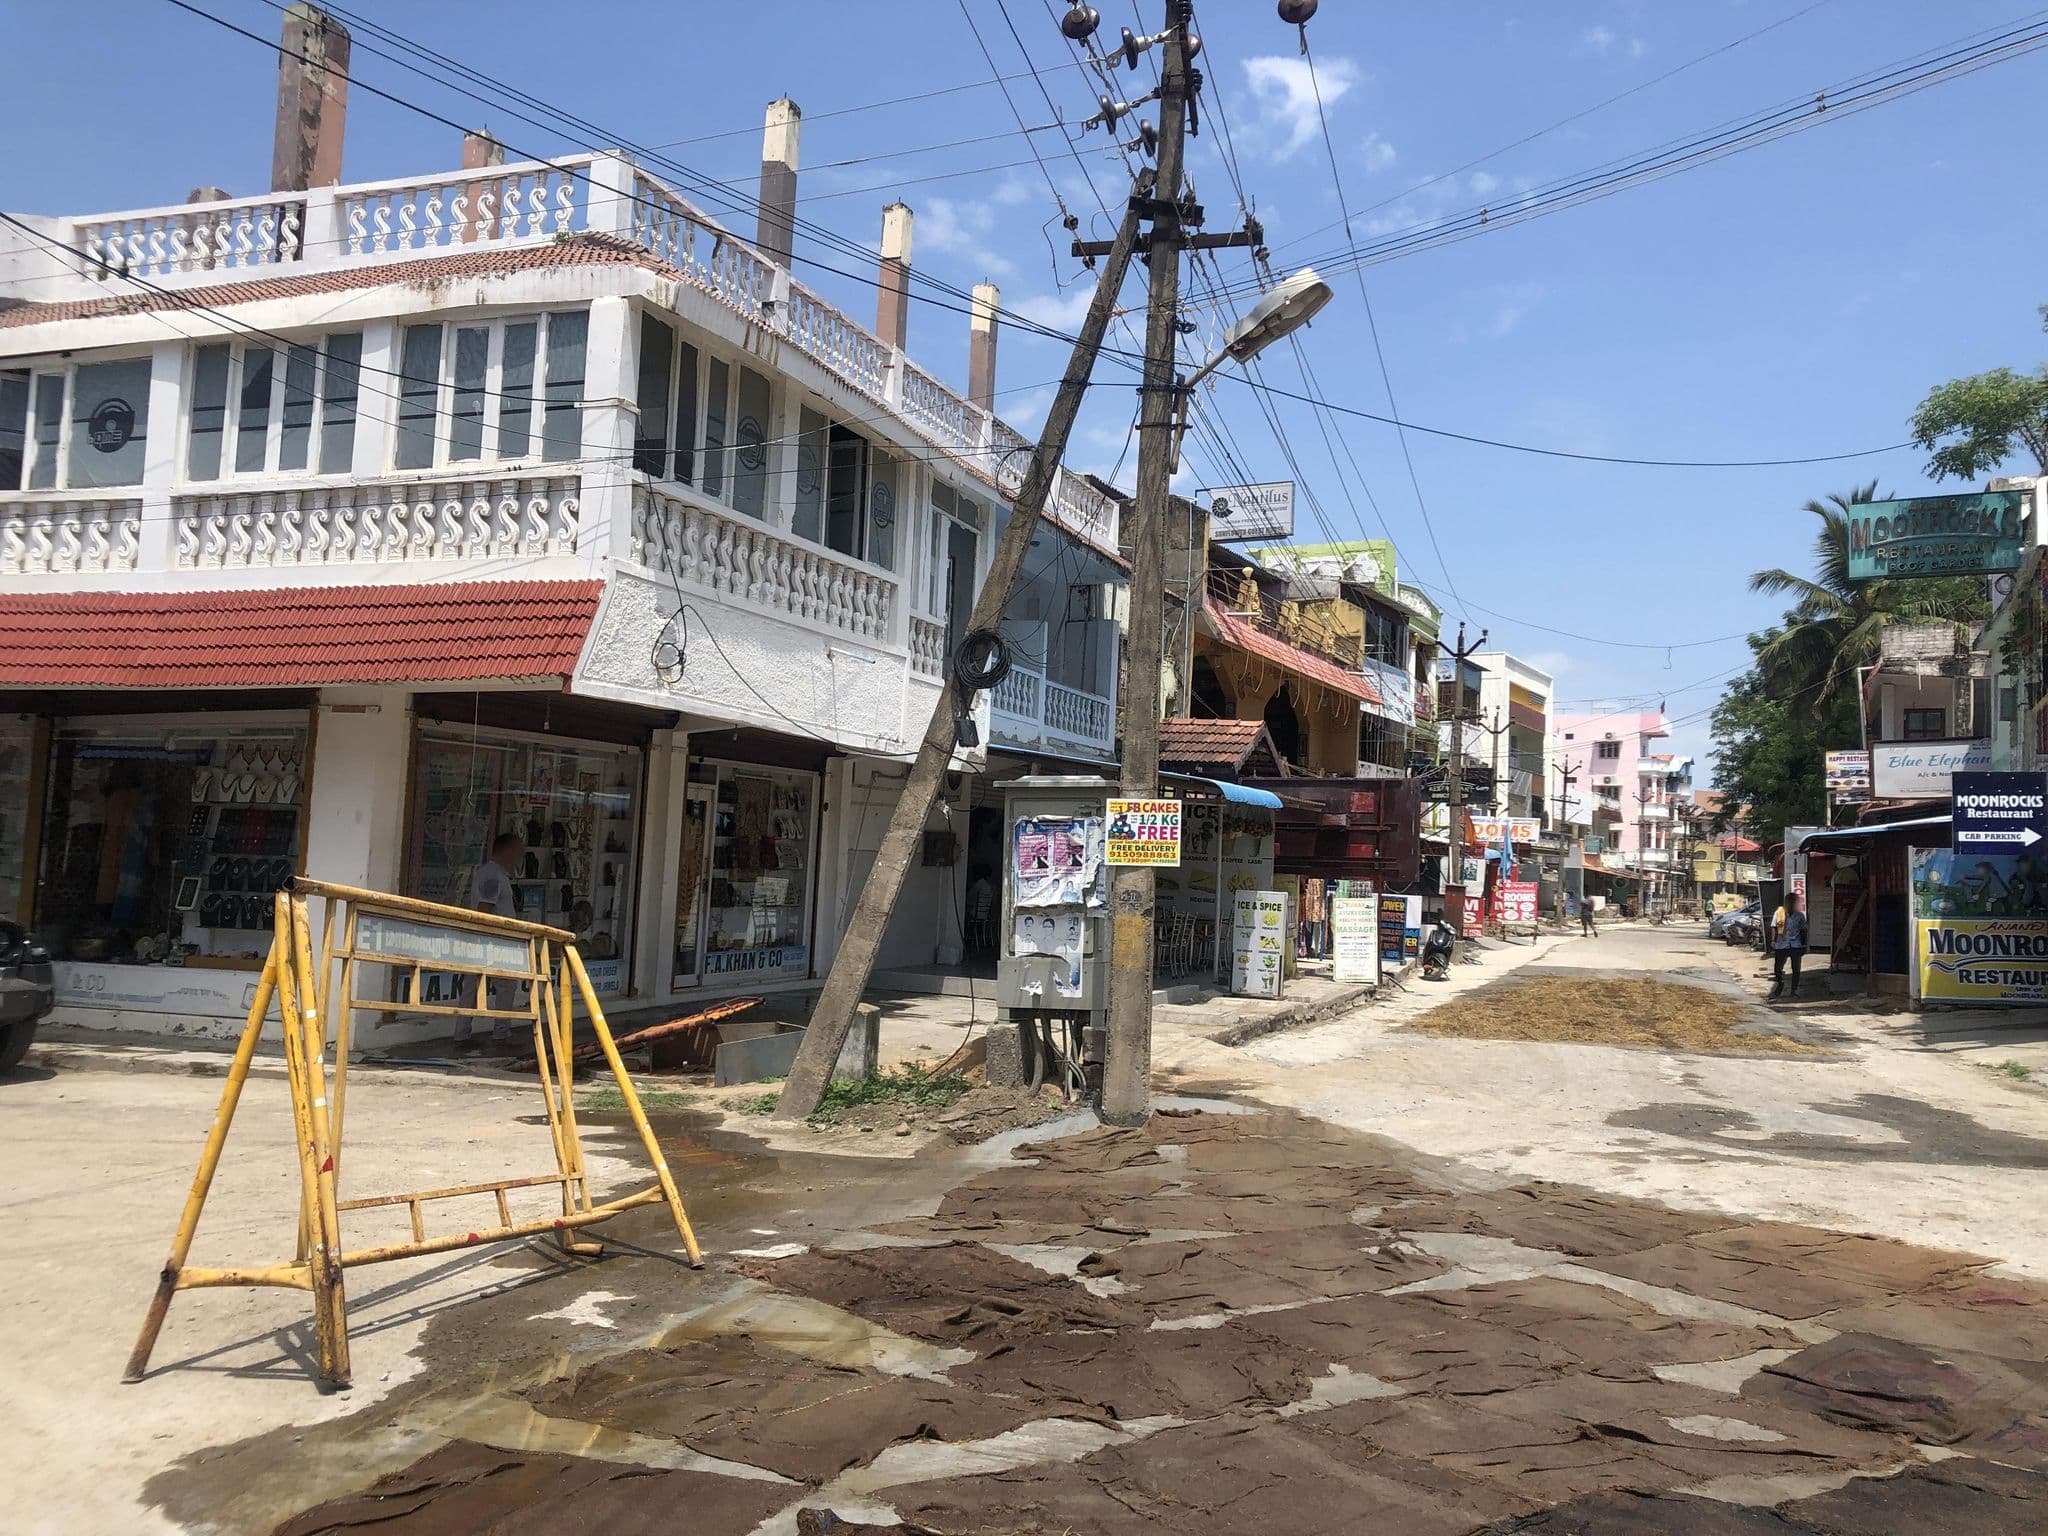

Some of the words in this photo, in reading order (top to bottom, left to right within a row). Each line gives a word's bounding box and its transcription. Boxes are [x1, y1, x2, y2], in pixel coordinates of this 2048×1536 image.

[1850, 506, 2019, 553] MOONROCKS
[1876, 541, 1996, 560] RESTAURANT
[1889, 560, 1926, 572] ROOF
[1930, 557, 1984, 569] GARDEN
[1888, 755, 1923, 768] Blue
[1928, 753, 1991, 769] Elephan
[1142, 802, 1179, 813] CAKES
[1957, 795, 2044, 808] MOONROCKS
[1967, 807, 2034, 819] Restaurant
[1139, 814, 1158, 825] 1/2
[1161, 814, 1179, 826] KG
[1137, 825, 1179, 841] FREE
[1109, 851, 1177, 859] 9150988863
[1503, 892, 1536, 902] ROOMS
[1237, 901, 1251, 910] ICE
[1252, 902, 1258, 910] &
[1259, 902, 1282, 912] SPICE
[356, 916, 383, 951] E1
[1336, 926, 1373, 934] MASSAGE
[704, 950, 756, 974] F.A.KHAN
[758, 951, 765, 969] &
[768, 949, 783, 967] CO
